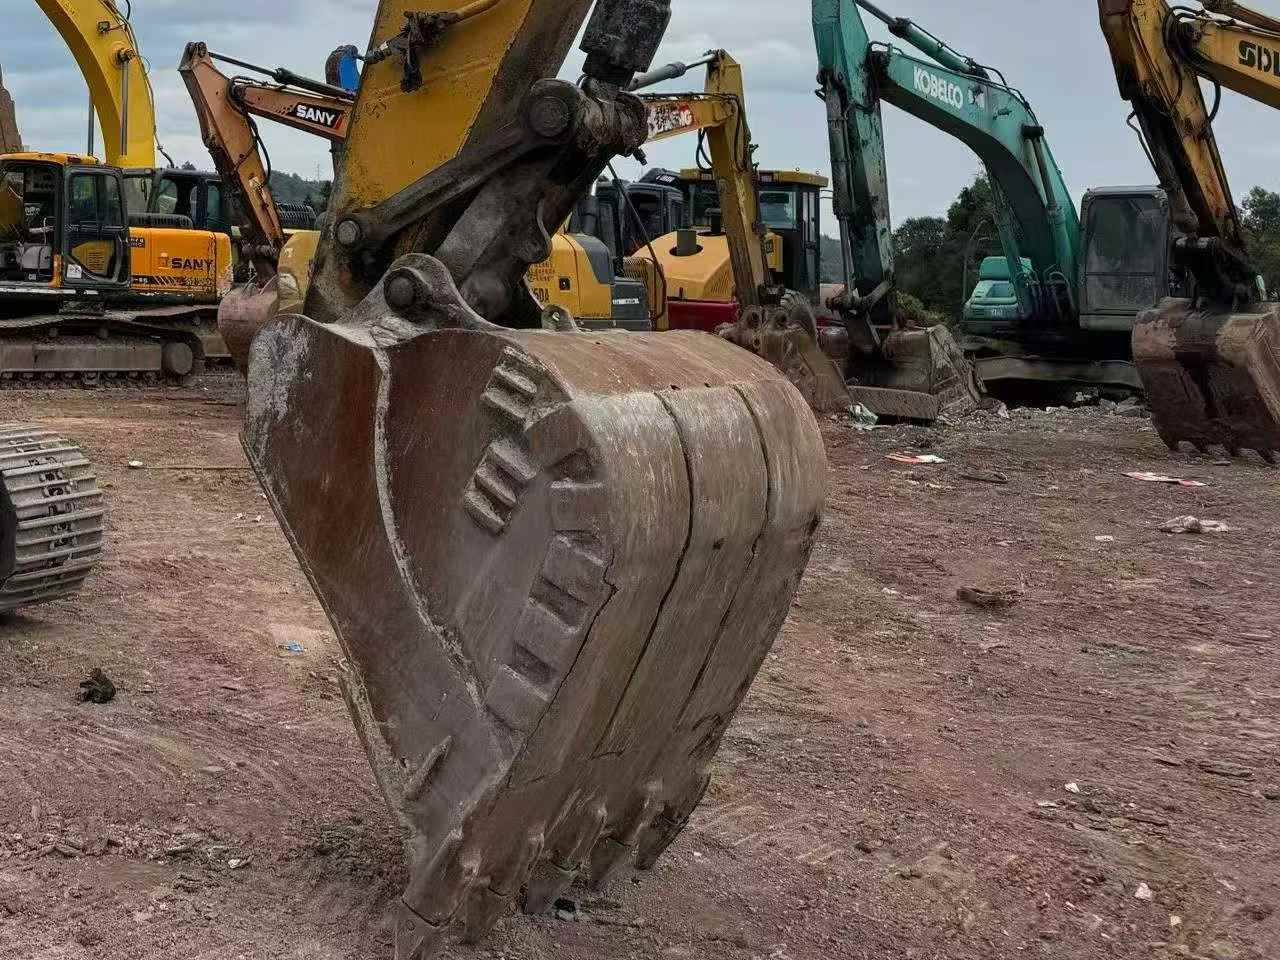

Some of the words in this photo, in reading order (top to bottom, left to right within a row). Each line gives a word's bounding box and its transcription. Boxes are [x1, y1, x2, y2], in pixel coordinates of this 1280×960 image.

[913, 64, 964, 109] KOBELCO
[296, 104, 336, 126] SANY
[171, 257, 215, 270] SANY
